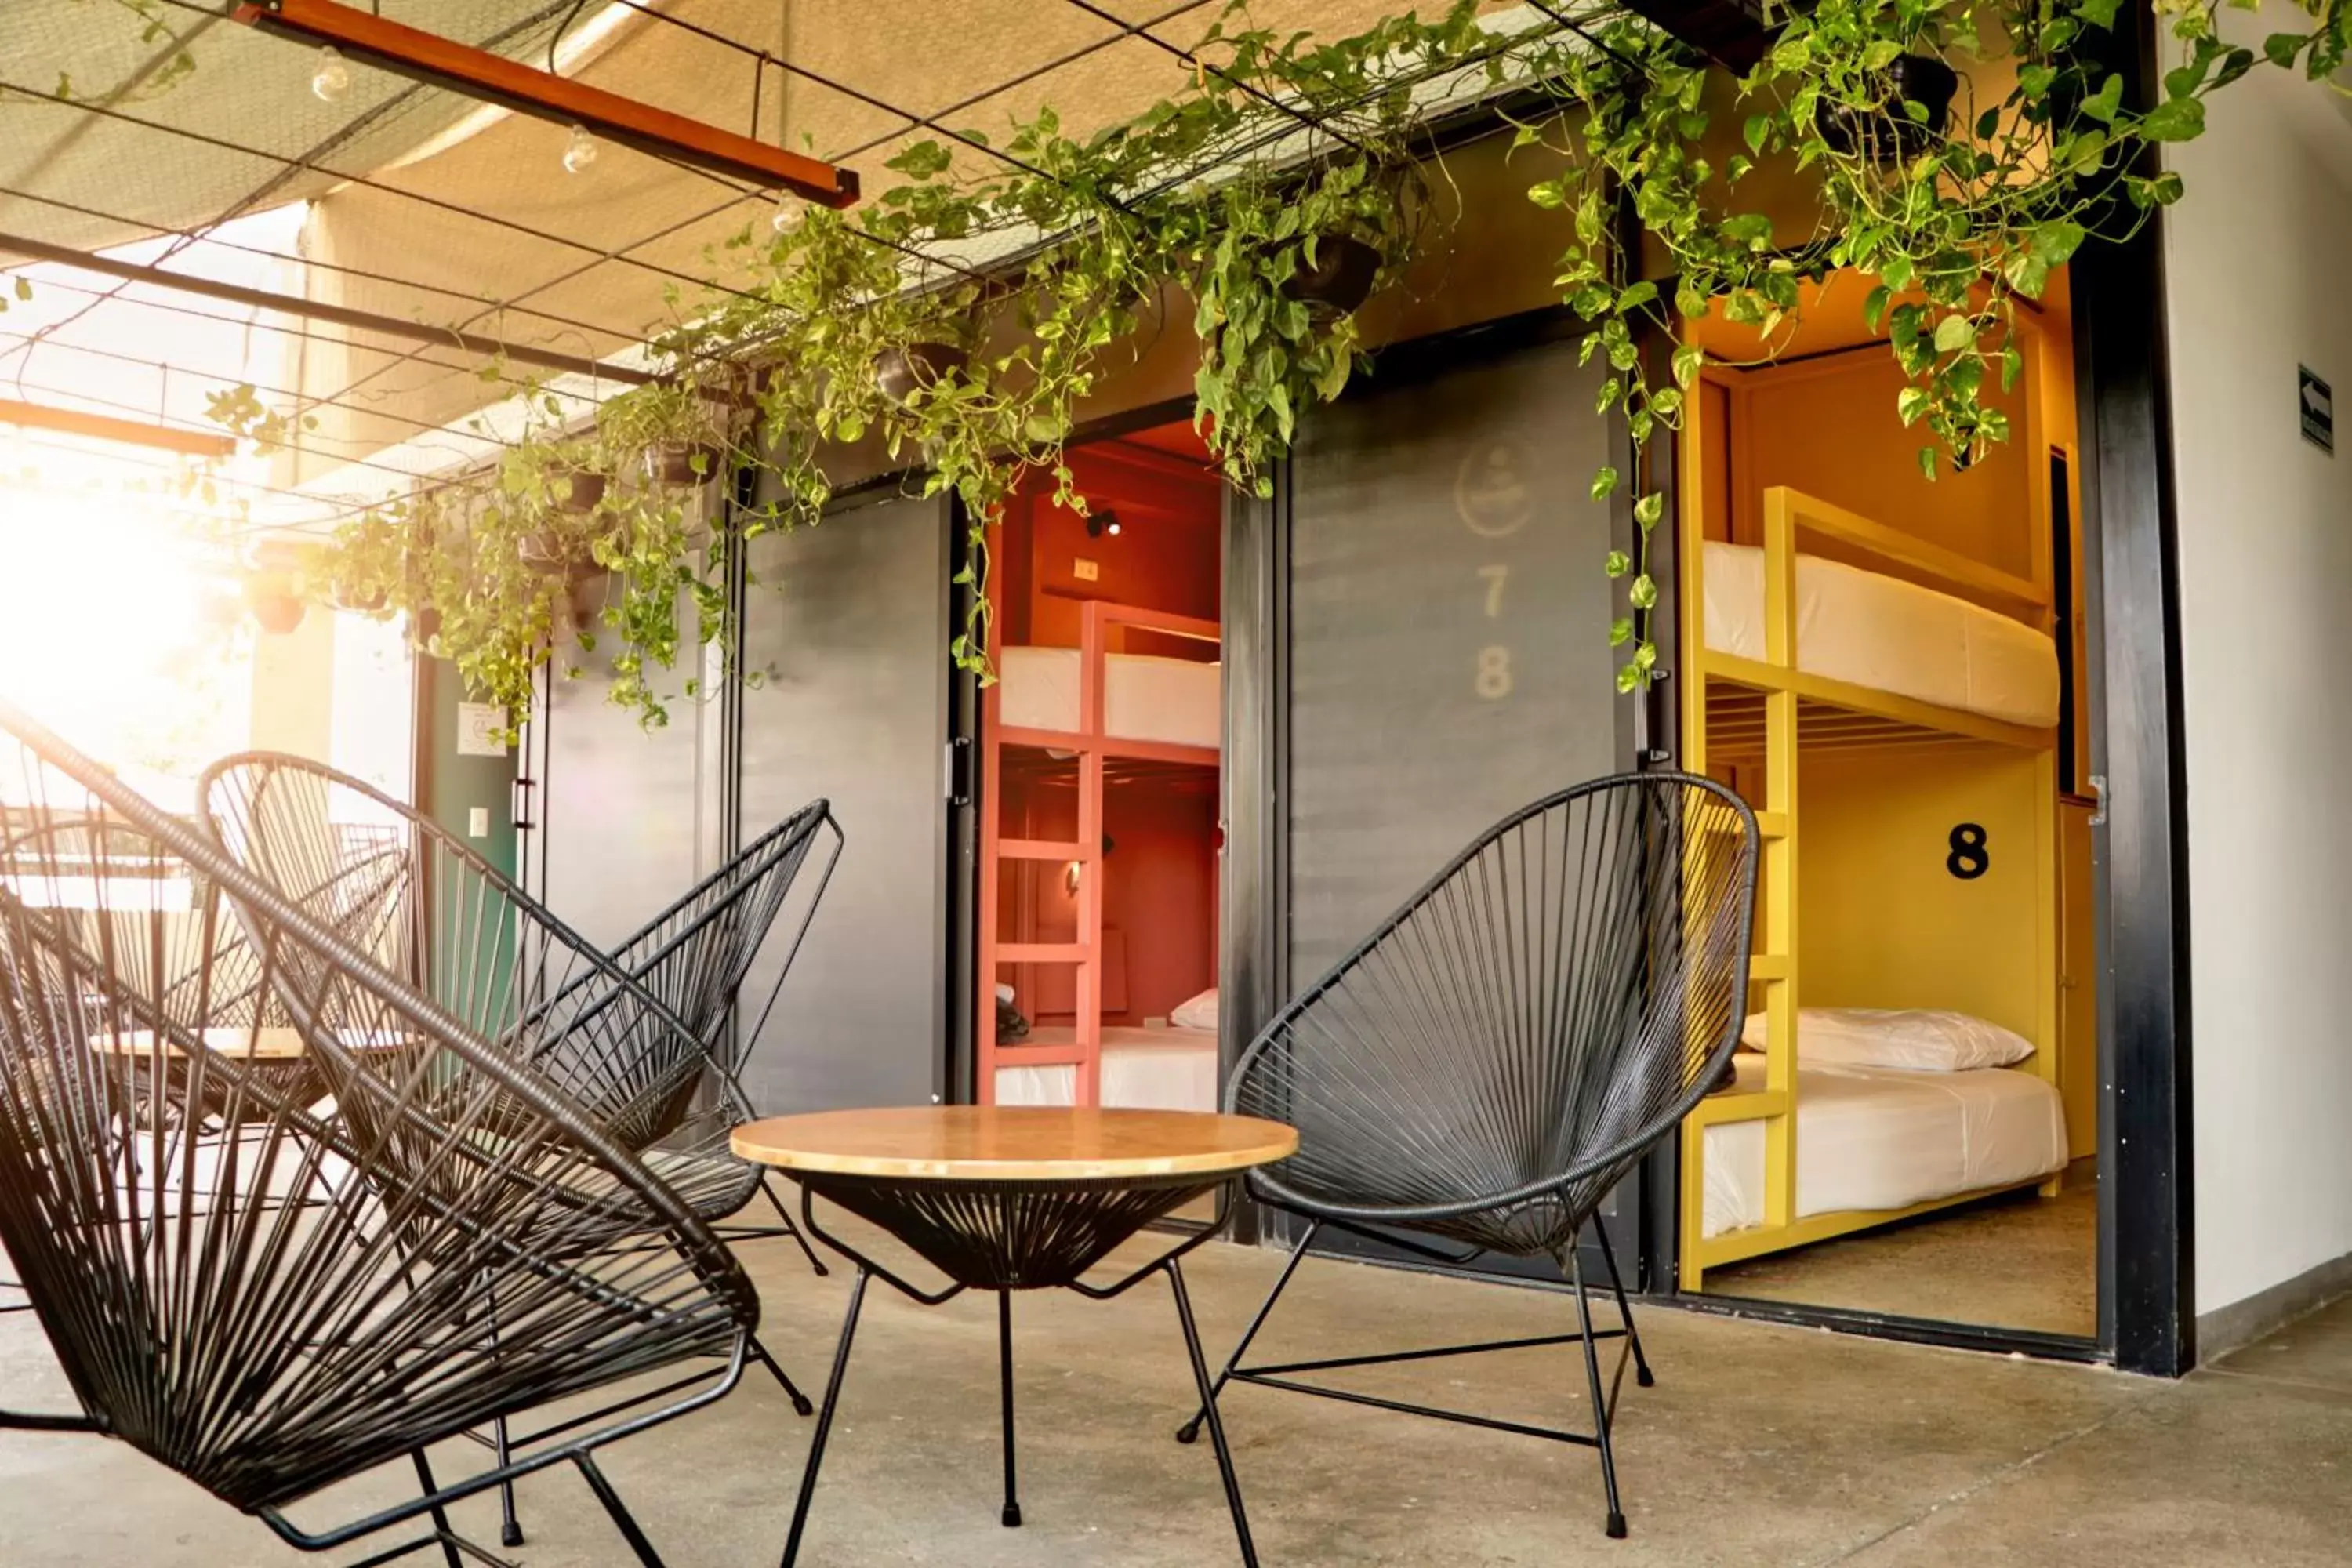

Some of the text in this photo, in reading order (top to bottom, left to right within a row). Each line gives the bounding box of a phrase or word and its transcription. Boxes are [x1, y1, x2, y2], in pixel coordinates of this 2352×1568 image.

[1477, 564, 1508, 618] 7
[1475, 645, 1512, 699] 8
[1947, 822, 1989, 880] 8
